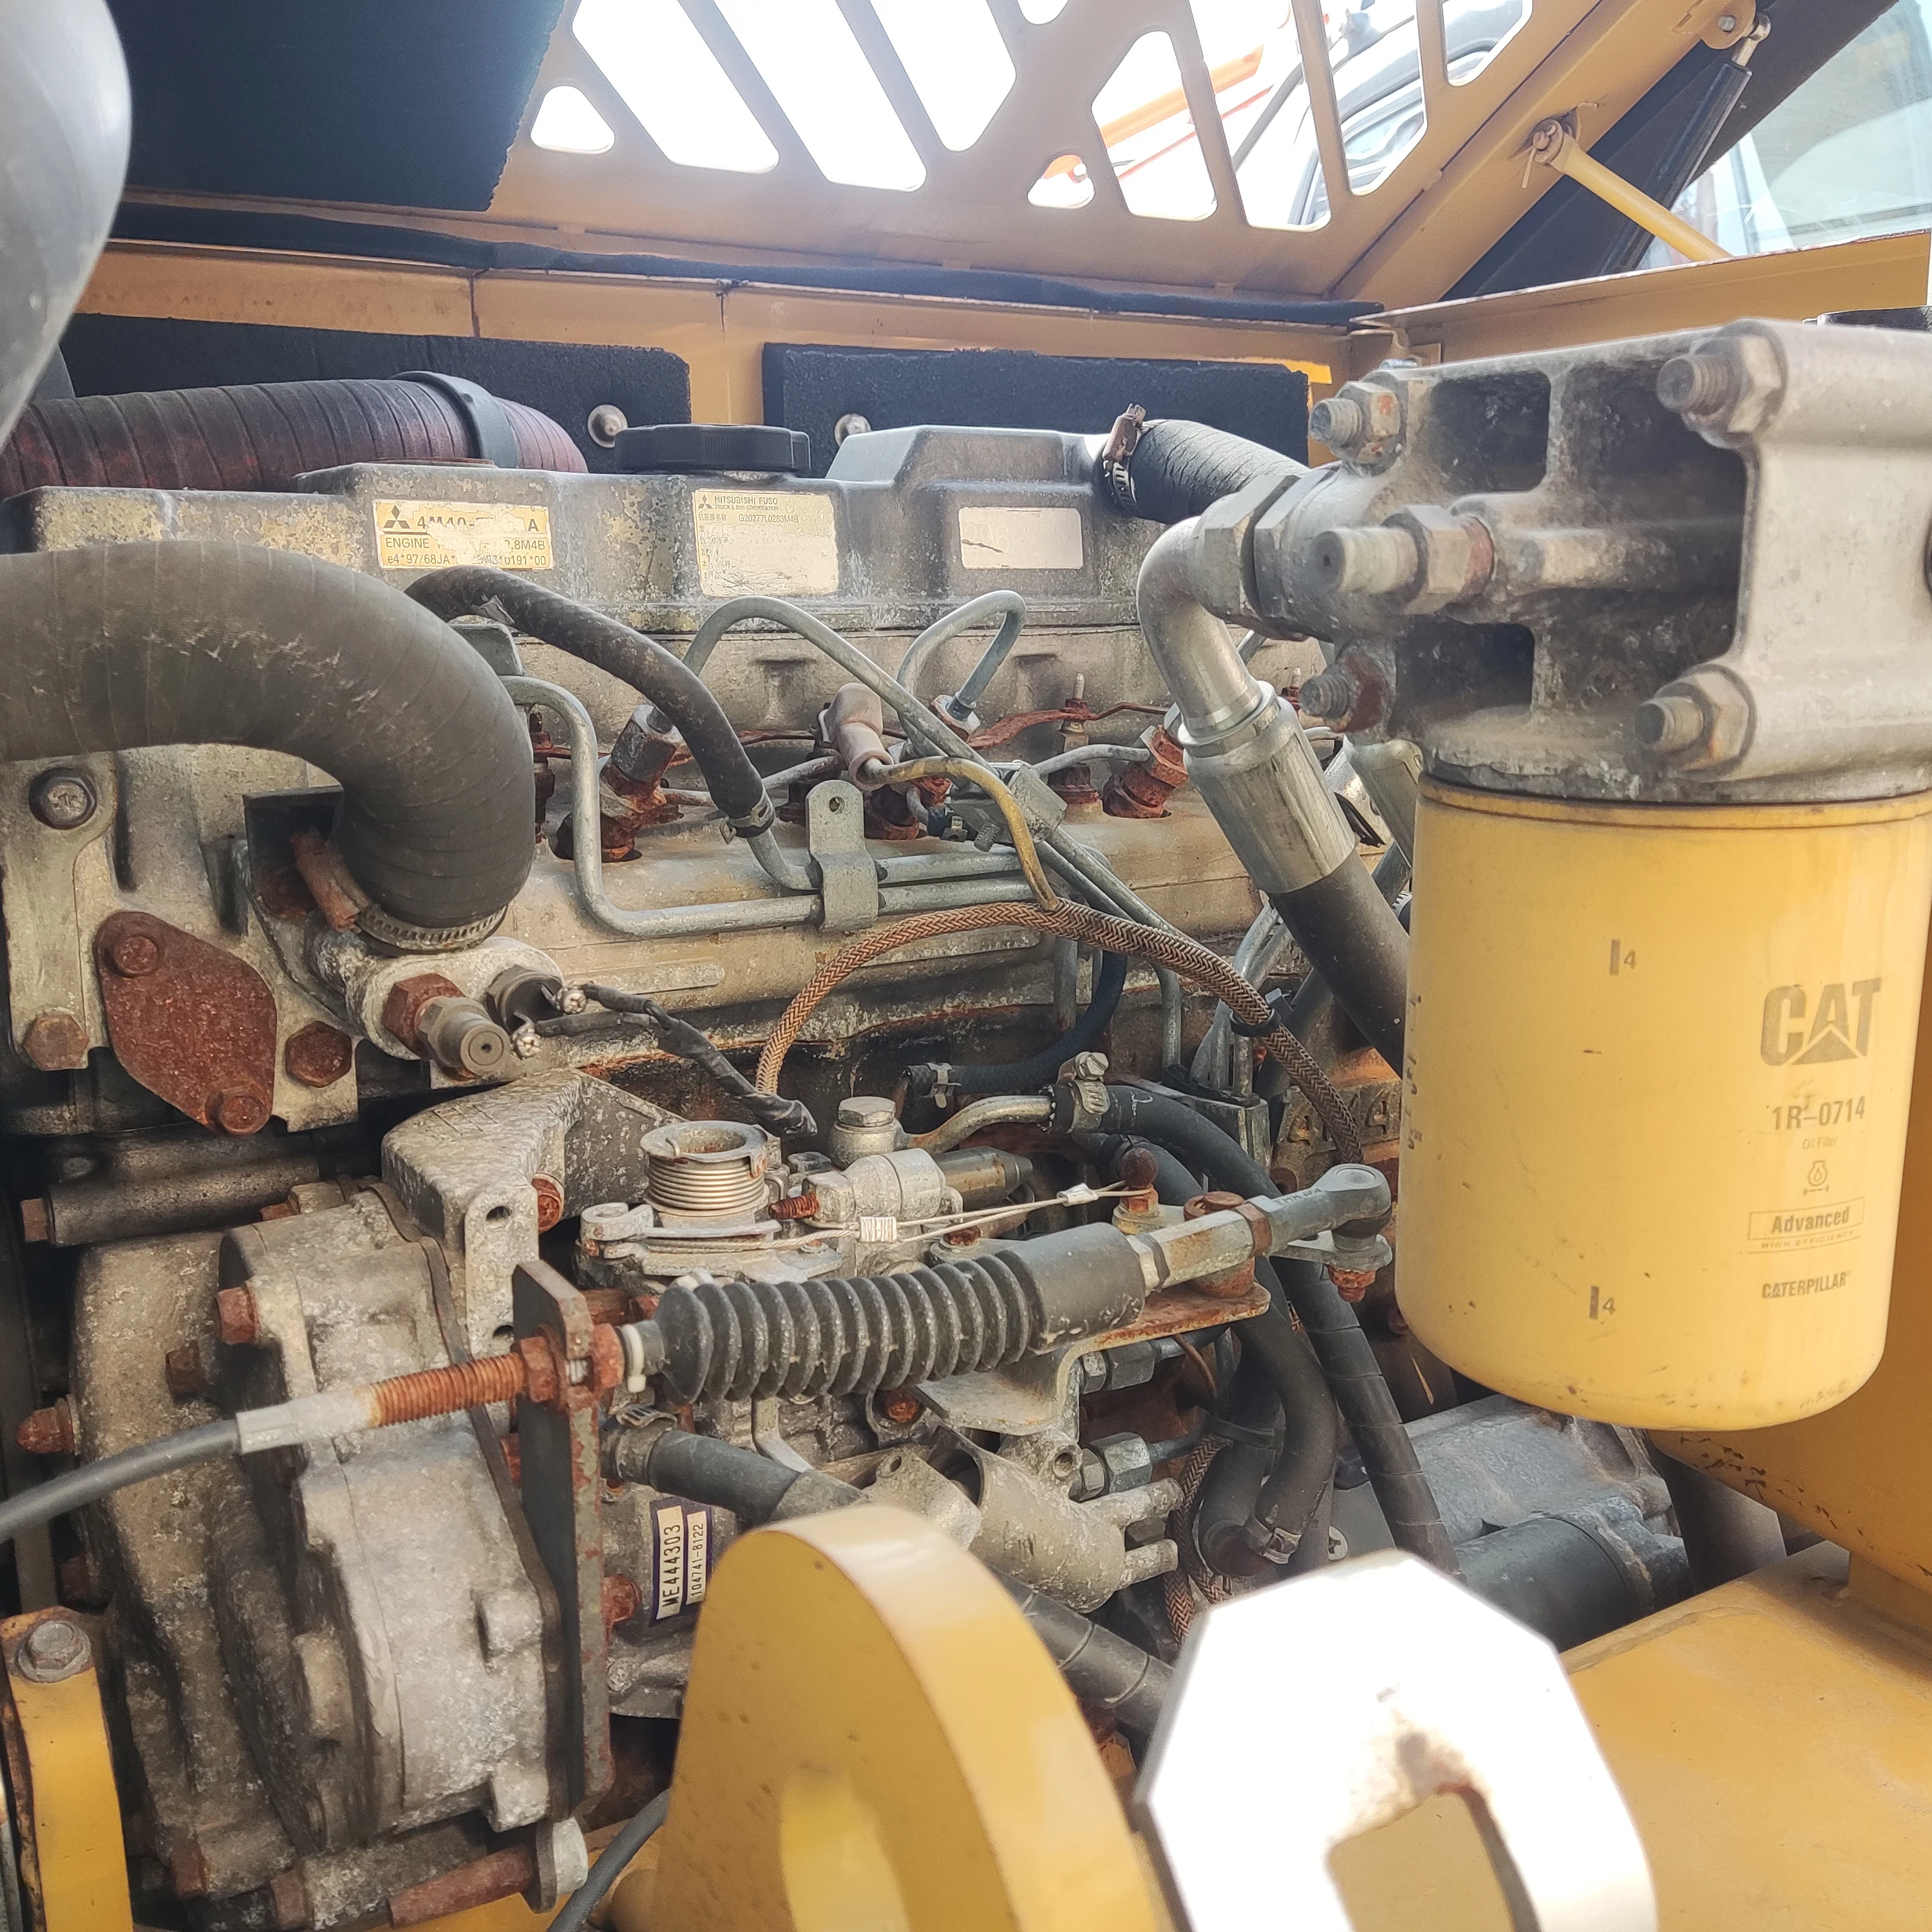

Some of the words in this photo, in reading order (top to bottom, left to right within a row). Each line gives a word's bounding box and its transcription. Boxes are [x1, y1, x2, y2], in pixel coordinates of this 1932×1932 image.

[714, 495, 756, 505] MITSUBISHI
[386, 537, 430, 549] ENGINE
[1761, 977, 1882, 1066] CAT
[1772, 1096, 1866, 1130] 1R-0714
[1273, 1195, 1302, 1206] THK
[1772, 1206, 1850, 1234] Advanced
[662, 1524, 681, 1608] ME444303
[691, 1523, 704, 1596] 104741-8122
